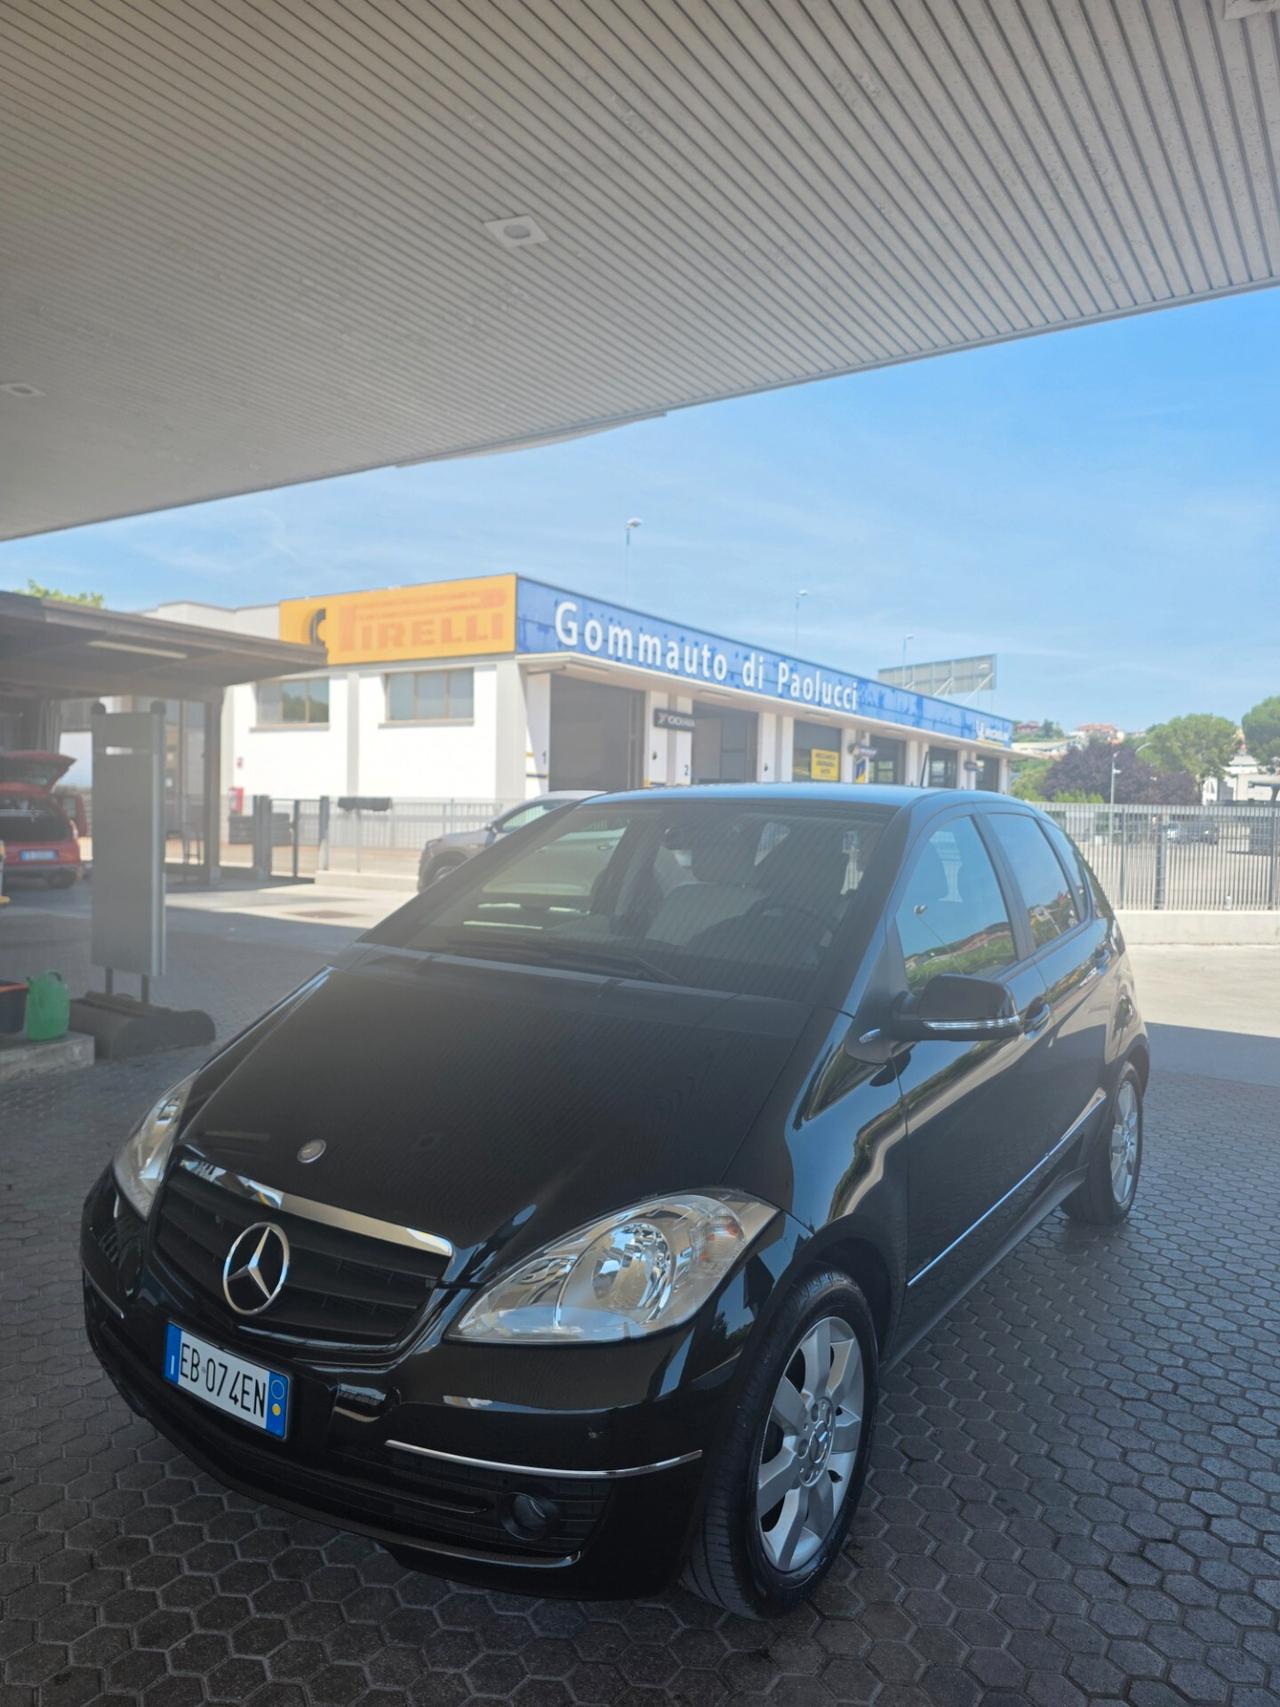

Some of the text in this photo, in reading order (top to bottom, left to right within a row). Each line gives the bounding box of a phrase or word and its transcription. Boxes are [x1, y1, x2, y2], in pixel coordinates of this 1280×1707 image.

[339, 588, 506, 651] PIRELLI
[555, 601, 858, 711] Gommauto di Paolucci
